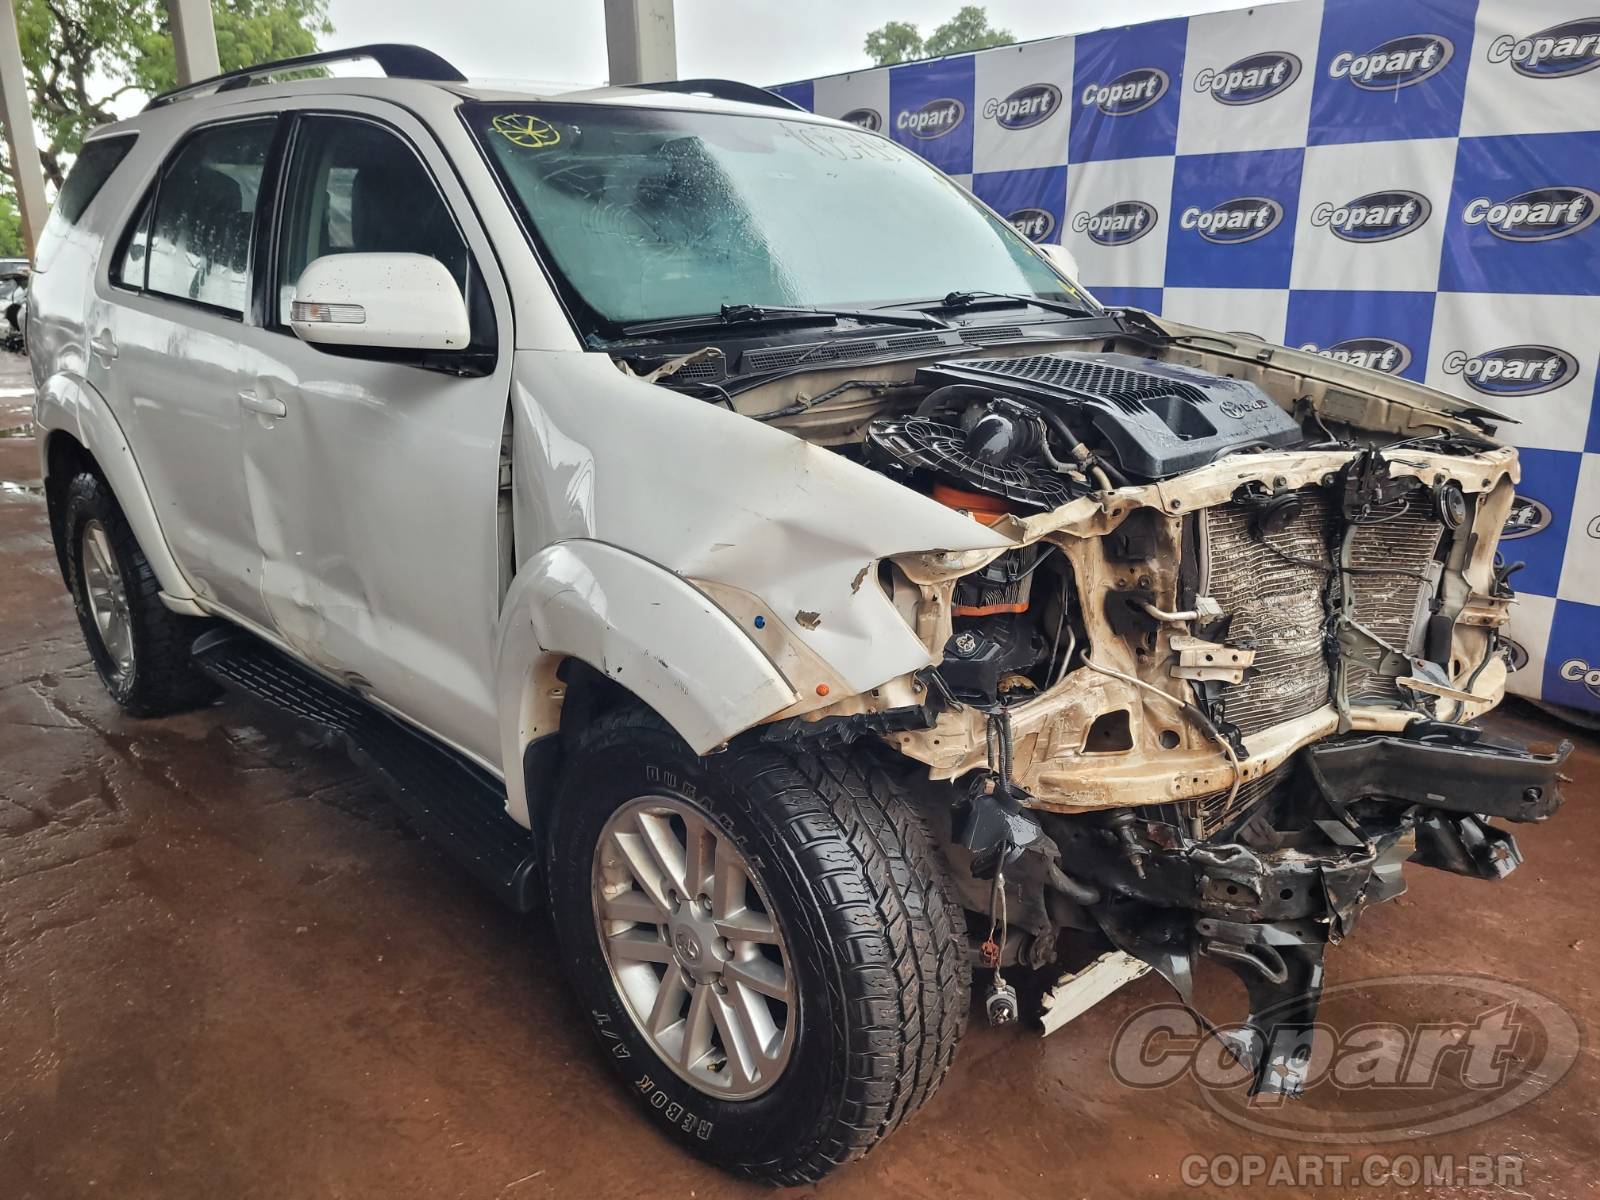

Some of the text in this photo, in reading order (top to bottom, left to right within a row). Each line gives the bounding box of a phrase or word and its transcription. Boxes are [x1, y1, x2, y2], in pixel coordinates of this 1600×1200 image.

[1194, 58, 1287, 95] Copart
[1329, 38, 1440, 81] Copart
[983, 90, 1053, 122] Copart
[1082, 71, 1159, 107] Copart
[897, 103, 958, 132] Copart
[1072, 206, 1147, 240] Copart
[1180, 200, 1271, 234] Copart
[1311, 195, 1419, 230] Copart
[1463, 195, 1588, 231] Copart
[1442, 350, 1562, 383] Copart
[635, 1075, 713, 1140] REBOK
